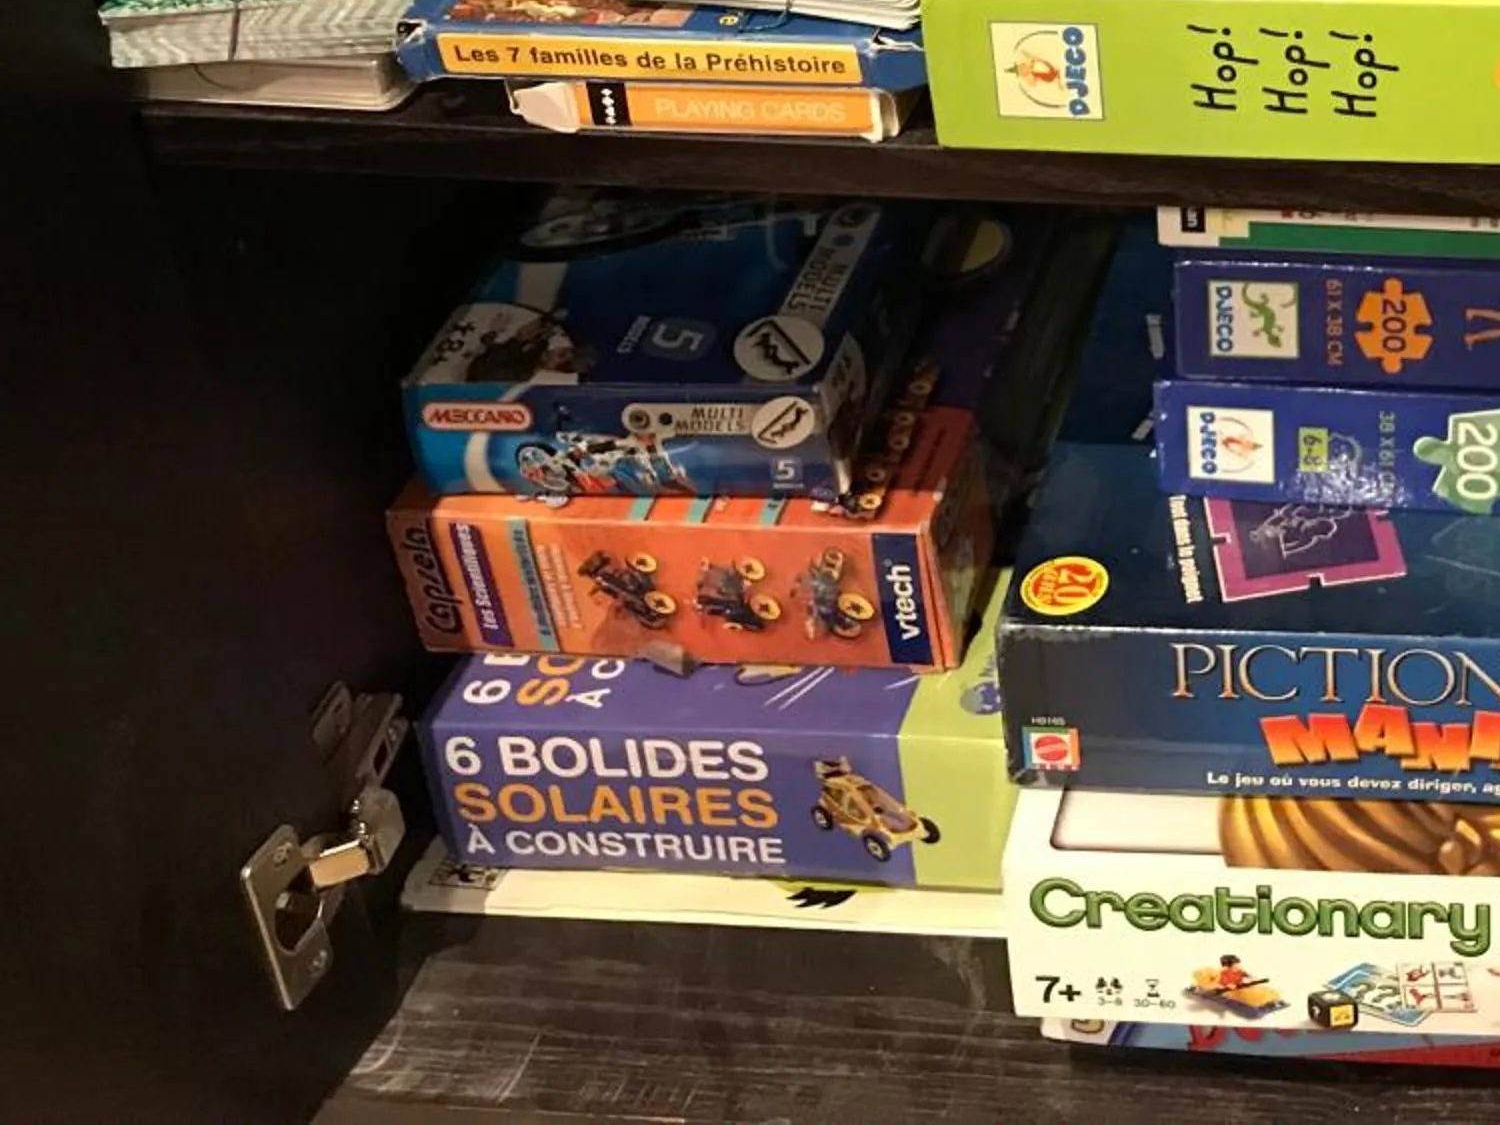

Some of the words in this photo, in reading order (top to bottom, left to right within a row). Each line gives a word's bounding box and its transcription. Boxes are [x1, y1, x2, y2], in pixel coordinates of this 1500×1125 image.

[455, 46, 499, 64] Les
[506, 46, 520, 64] 7
[528, 47, 626, 68] familles
[636, 50, 665, 69] de
[675, 52, 697, 70] la
[706, 51, 845, 75] Préhistoire
[1063, 26, 1089, 116] DJECO
[655, 99, 755, 121] PLAYING
[761, 99, 845, 122] CARDS
[1216, 285, 1233, 353] DJECO
[1382, 299, 1407, 353] 200
[428, 409, 526, 425] MECCANO
[675, 421, 746, 432] MODELS
[690, 407, 745, 420] MULTI
[1200, 413, 1216, 473] DJECO
[1456, 422, 1498, 500] 200
[776, 461, 795, 480] 5
[404, 520, 463, 633] Capsela
[454, 523, 494, 600] Scientifiques
[890, 564, 921, 641] vtech
[1055, 565, 1094, 605] 20
[484, 603, 502, 631] Les
[464, 679, 511, 704] 6
[446, 737, 481, 776] 6
[498, 736, 768, 781] BOLIDES
[1207, 773, 1230, 786] Le
[1234, 773, 1264, 789] jeu
[1269, 773, 1293, 787] où
[1299, 778, 1343, 789] vous
[1348, 776, 1401, 789] devez
[1407, 777, 1477, 795] diriger,
[454, 784, 779, 828] SOLAIRES
[466, 822, 495, 855] À
[506, 831, 786, 865] CONSTRUIRE
[1029, 877, 1492, 957] Creationary
[1035, 976, 1081, 1004] 7+
